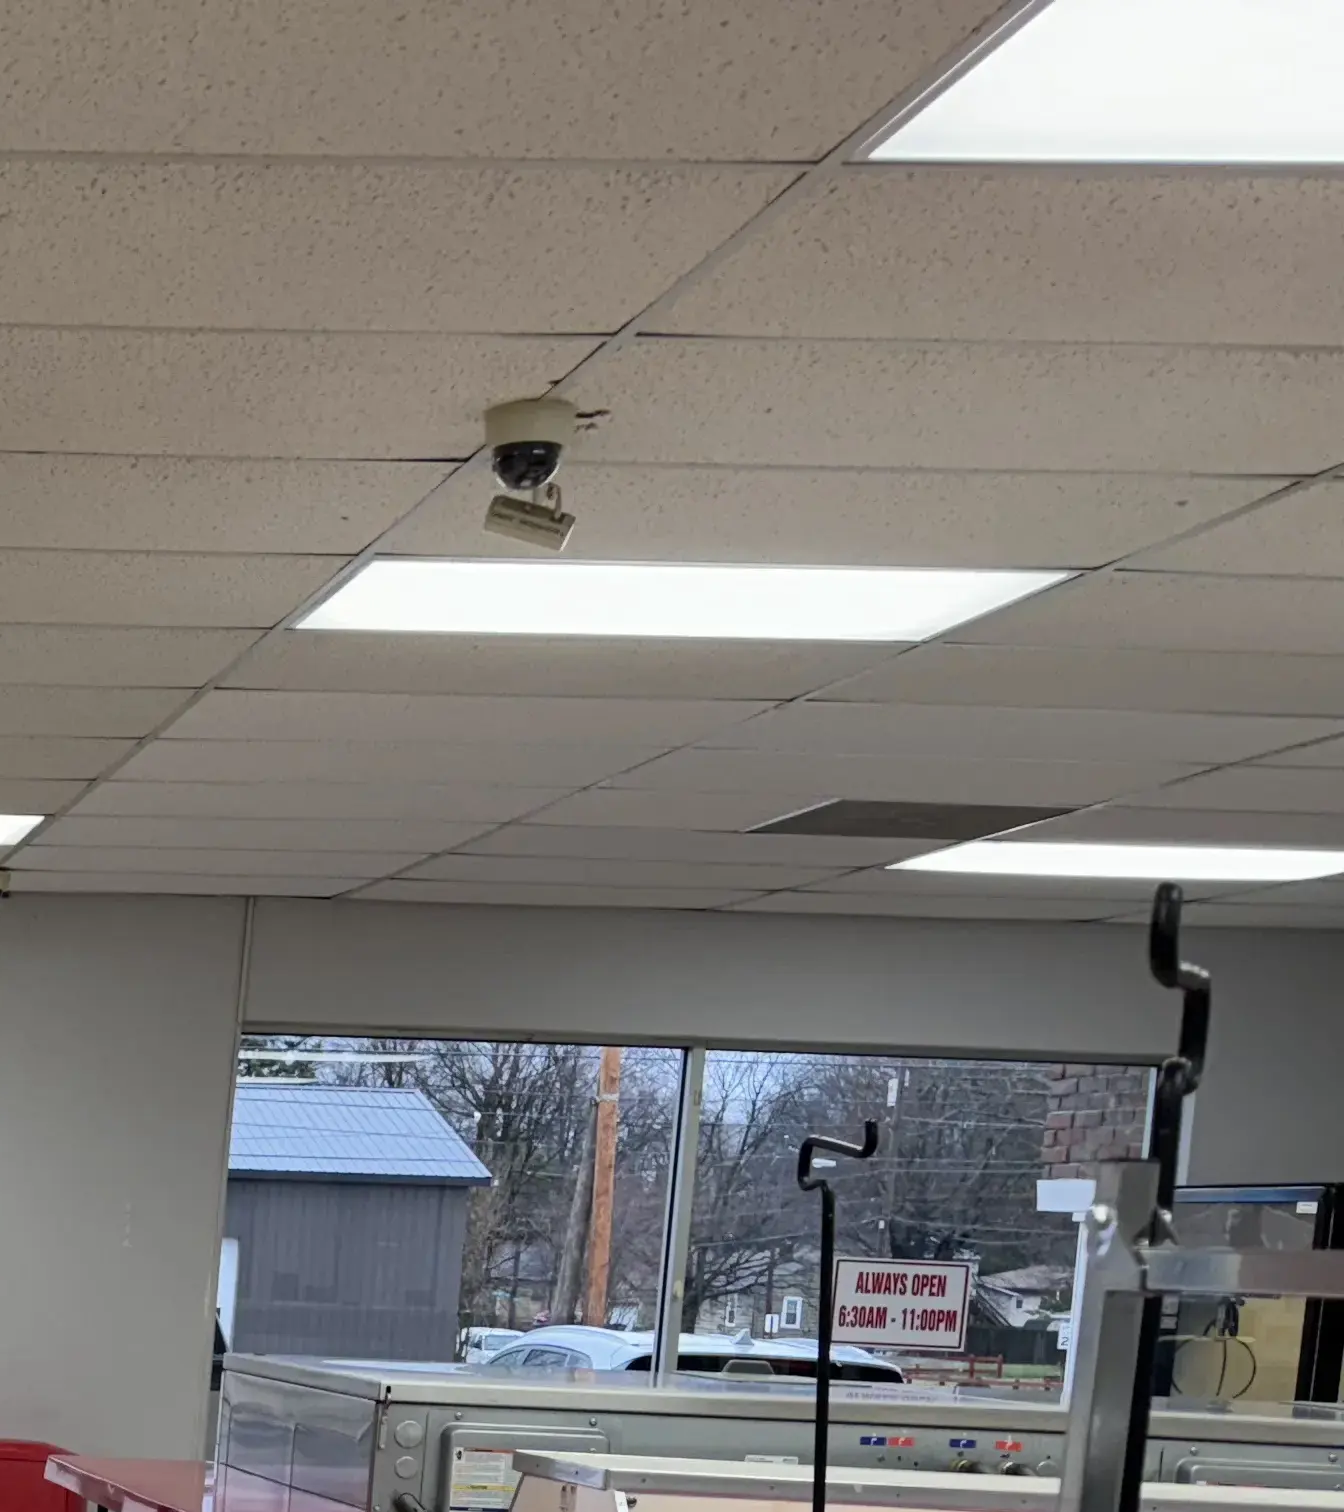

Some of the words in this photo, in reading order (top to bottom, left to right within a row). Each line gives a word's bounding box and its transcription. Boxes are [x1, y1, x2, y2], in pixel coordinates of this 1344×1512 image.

[855, 1271, 908, 1296] ALWAYS
[911, 1273, 947, 1298] OPEN
[838, 1305, 888, 1329] 6:30AM
[901, 1307, 958, 1332] 11:00PM
